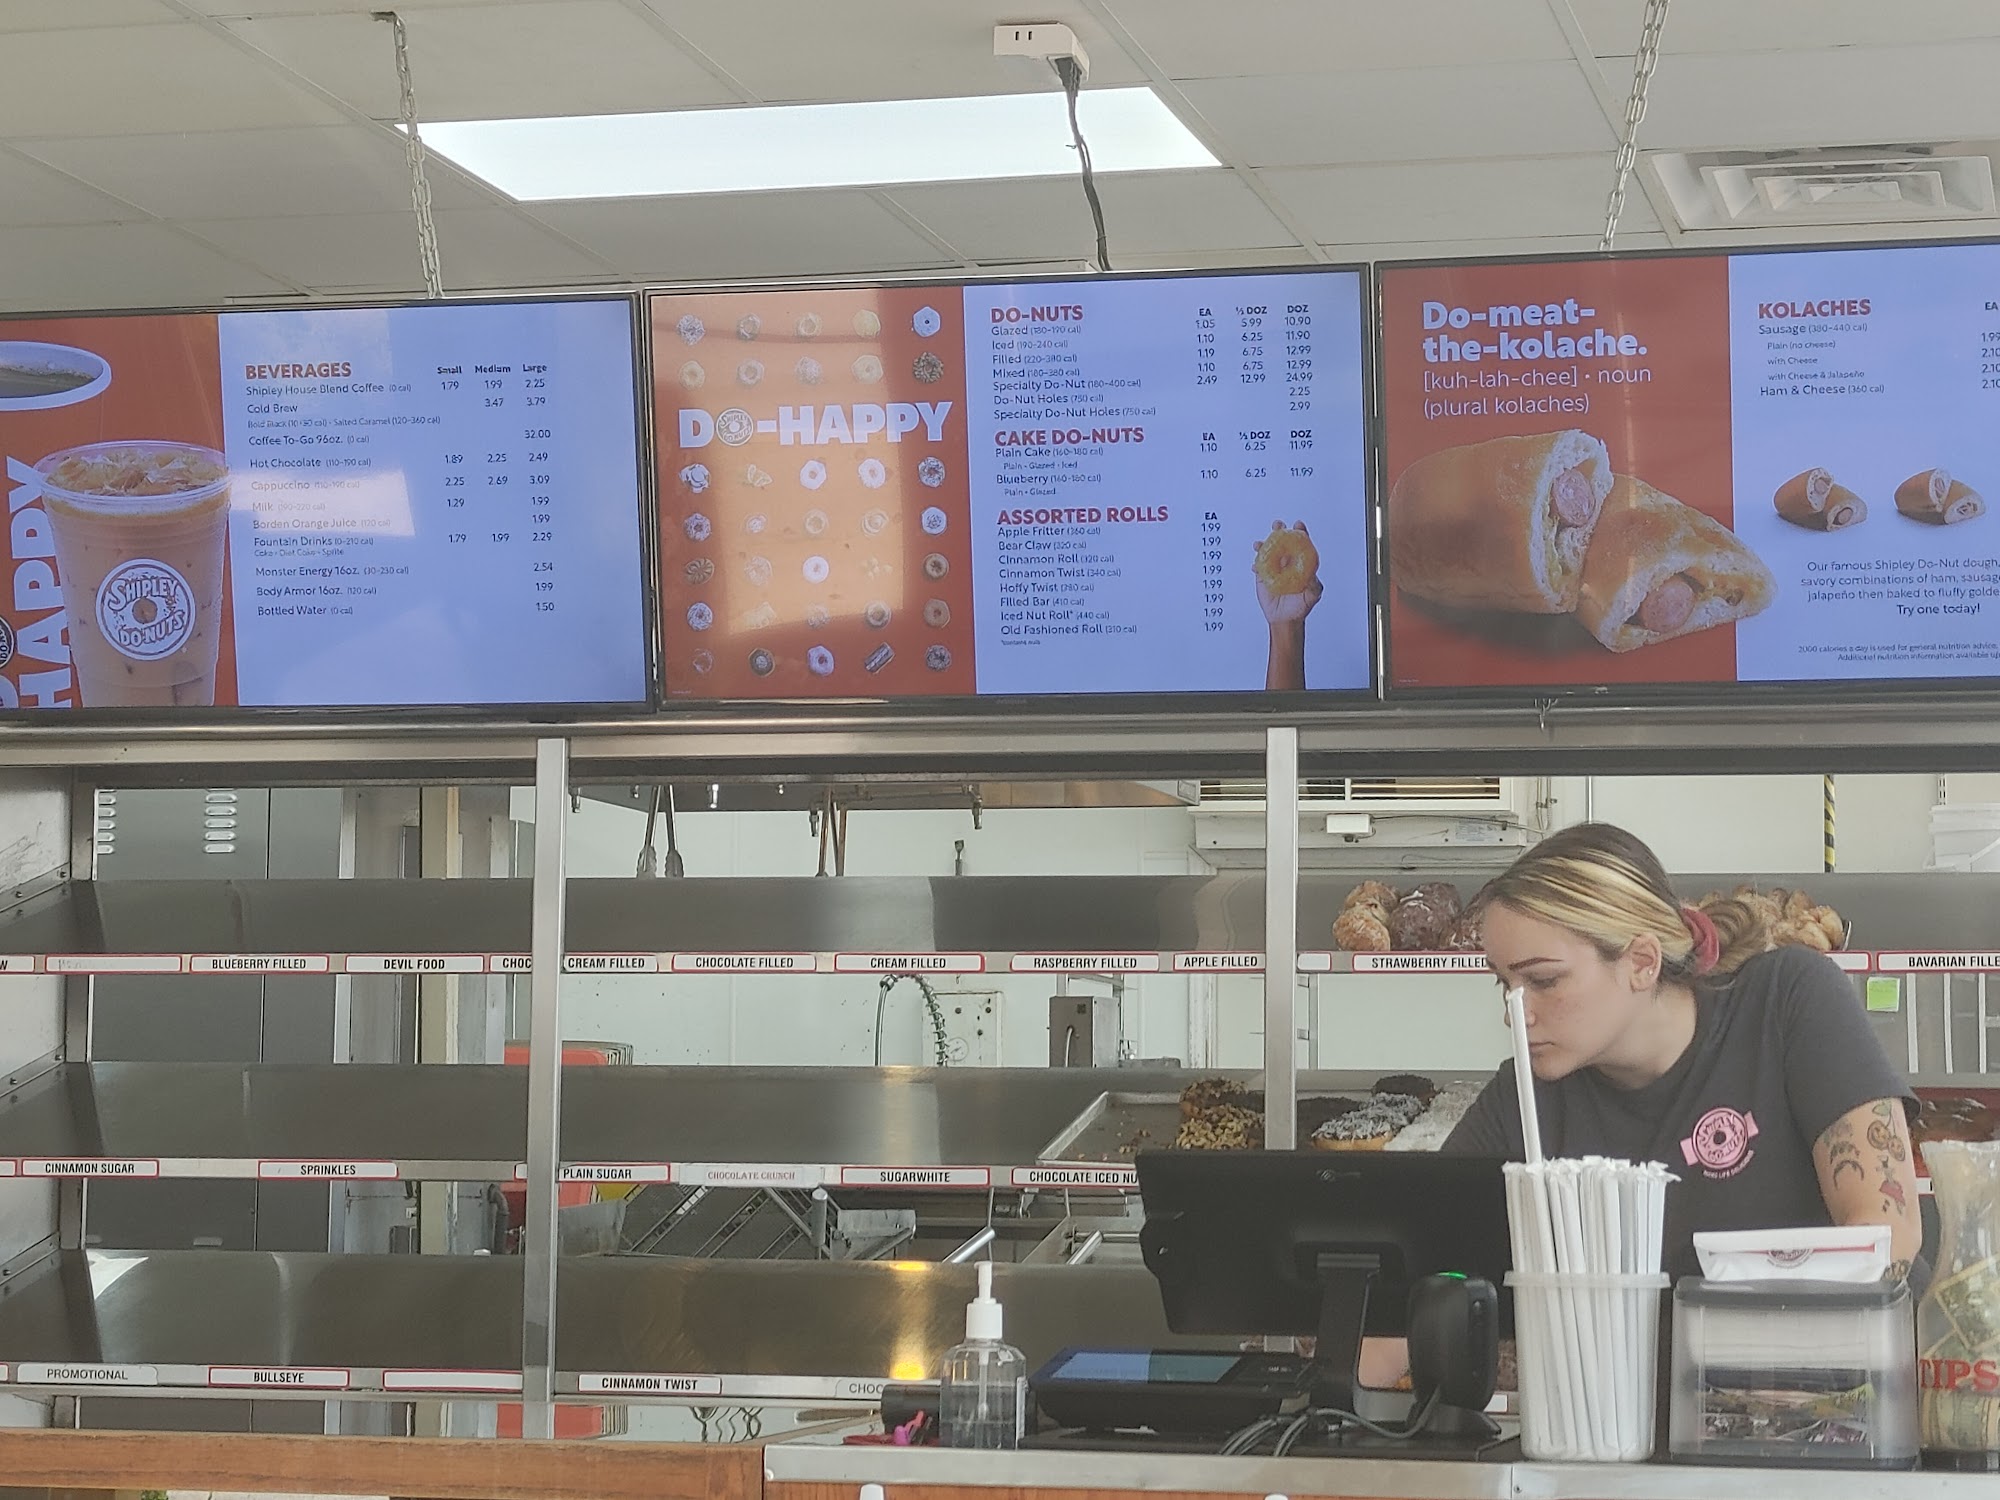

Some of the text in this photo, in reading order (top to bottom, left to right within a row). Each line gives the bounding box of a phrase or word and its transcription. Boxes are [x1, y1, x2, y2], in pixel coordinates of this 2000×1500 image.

[1246, 306, 1267, 314] DOZ
[1287, 305, 1308, 313] DOZ
[1758, 299, 1871, 319] KOLACHES
[1985, 301, 1998, 310] EA
[991, 305, 1083, 323] DO-NUTS
[1199, 308, 1212, 316] EA
[1422, 298, 1595, 329] Do-meat-
[1284, 316, 1311, 326] 10.90
[991, 325, 1027, 335] Glazed
[1759, 324, 1806, 335] Sausage
[1285, 330, 1310, 340] 11.90
[1286, 345, 1311, 355] 12.99
[1422, 328, 1647, 362] the-kolache.
[1242, 347, 1263, 356] 6.75
[992, 354, 1021, 364] Filled
[1287, 359, 1311, 369] 12.99
[245, 362, 352, 379] BEVERAGES
[437, 365, 462, 374] Small
[475, 364, 511, 373] Medium
[522, 364, 547, 373] Large
[1243, 361, 1263, 370] 6.75
[993, 368, 1025, 378] Mixed
[1240, 373, 1265, 383] 12.99
[1286, 372, 1312, 382] 24.99
[1197, 375, 1217, 384] 2.49
[1424, 365, 1651, 392] [kuh-lah-chee] noun
[246, 383, 384, 397] Shipley House Blend Coffee
[993, 379, 1085, 392] Specialty Do-Nut
[1760, 385, 1845, 396] Ham Cheese
[1289, 386, 1310, 396] 2.25
[994, 394, 1068, 405] Do-Nut Holes
[247, 403, 298, 413] Cold Brew
[1290, 401, 1310, 411] 2.99
[1424, 393, 1589, 420] (plural kolaches)
[994, 407, 1120, 420] Specialty Do-Nut Holes
[524, 429, 551, 439] 32.00
[994, 427, 1144, 446] CAKE DO-NUTS
[1202, 432, 1215, 440] EA
[1250, 431, 1271, 439] DOZ
[1290, 429, 1312, 438] DOZ
[248, 435, 314, 445] Coffee To-Go
[1289, 440, 1313, 450] 11.99
[1245, 441, 1266, 450] 6.25
[995, 447, 1050, 457] Plain Cake
[250, 458, 321, 468] Hot Chocolate
[487, 453, 507, 463] 2.25
[1245, 468, 1266, 478] 6.25
[488, 475, 508, 485] 2.69
[529, 475, 550, 484] 3.09
[996, 474, 1048, 485] Blueberry
[251, 481, 310, 491] Cappuccino
[252, 502, 273, 511] Milk
[997, 506, 1168, 525] ASSORTED ROLLS
[1205, 512, 1217, 520] EA
[253, 517, 356, 529] Borden Orange Juice
[532, 532, 552, 541] 2.29
[998, 526, 1064, 538] Apple Fritter
[254, 536, 332, 546] Fountain Drinks
[998, 540, 1051, 550] Bear Claw
[998, 554, 1054, 564] Cinnamon
[1807, 559, 1959, 571] Our famous Shipley Do-Nut
[255, 567, 332, 577] Monster Energy
[999, 567, 1085, 578] Cinnamon Twist
[1801, 574, 1914, 587] savory combinations
[256, 587, 316, 597] Body Armor
[1031, 582, 1058, 592] Twist
[1858, 589, 1883, 599] then
[1887, 588, 1920, 598] baked
[1969, 587, 2000, 598] golde
[1000, 596, 1050, 606] Filled Bar
[258, 606, 326, 616] Bottled Water
[1897, 603, 1980, 616] Try one today!
[1001, 611, 1023, 620] Iced
[1026, 611, 1046, 620] Nut
[1001, 624, 1103, 634] Old Fashioned Roll
[212, 958, 307, 969] BLUEBERRY FILLED
[384, 959, 445, 969] DEVIL FOOD
[502, 958, 645, 969] CHOC CREAM FILLED
[695, 957, 793, 968] CHOCOLATE FILLED
[870, 957, 946, 968] CREAM FILLED
[1033, 957, 1137, 968] RASPBERRY FILLED
[1184, 956, 1258, 967] APPLE FILLED
[1371, 957, 1447, 968] STRAWBERRY
[1908, 956, 2000, 967] BAVARIAN FILLE
[45, 1162, 135, 1174] CINNAMON SUGAR
[300, 1164, 356, 1175] SPRINKLES
[563, 1168, 632, 1179] PLAIN SUGAR
[707, 1170, 796, 1180] CHOCOLATE CRUNCH
[880, 1171, 950, 1183] SUGARWHITE
[1029, 1171, 1138, 1183] CHOCOLATE ICED NU
[47, 1368, 128, 1381] PROMOTIONAL
[253, 1372, 304, 1384] BULLSEYE
[1919, 1358, 1999, 1392] TIPS
[601, 1378, 698, 1390] CINNAMON TWIST
